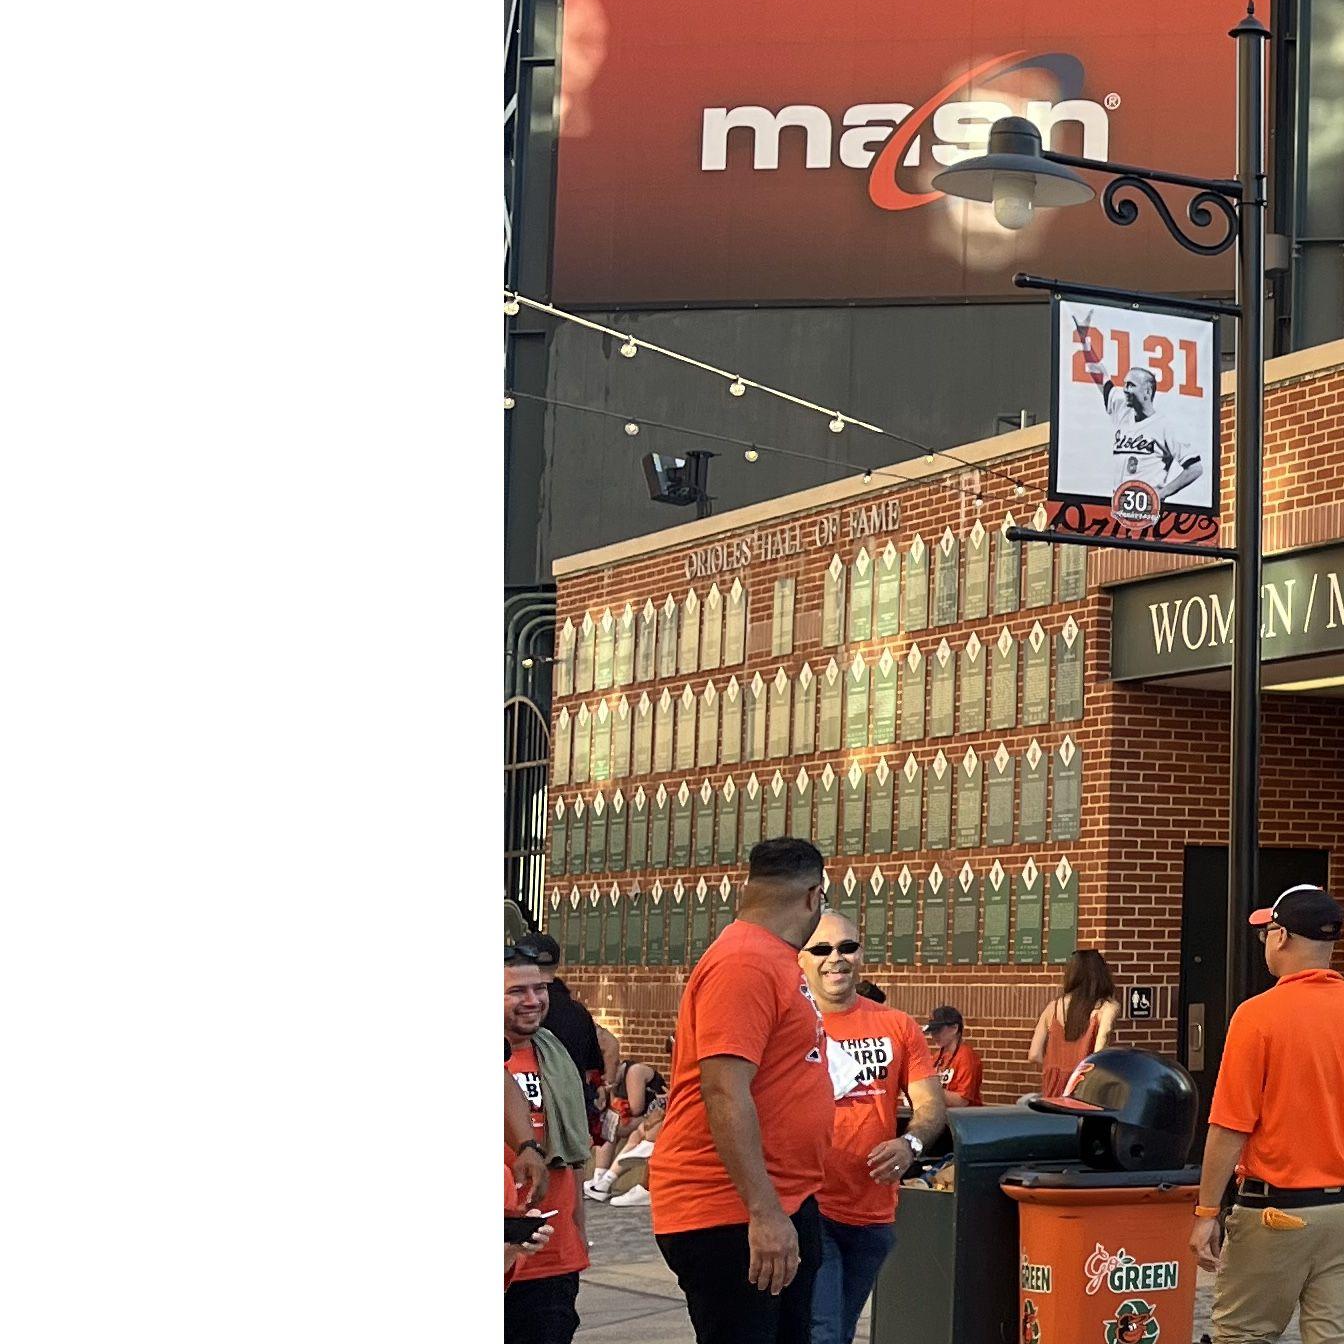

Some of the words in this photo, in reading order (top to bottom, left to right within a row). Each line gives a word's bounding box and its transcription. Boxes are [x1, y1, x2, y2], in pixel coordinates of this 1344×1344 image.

[1072, 326, 1204, 398] 2131
[1123, 490, 1148, 512] 30
[760, 524, 806, 562] HALL
[815, 509, 842, 547] OF
[849, 499, 901, 539] FAME
[1149, 579, 1297, 655] WOMN
[850, 1048, 887, 1065] IRD
[854, 1065, 889, 1083] AND
[1108, 1260, 1179, 1294] GREEN
